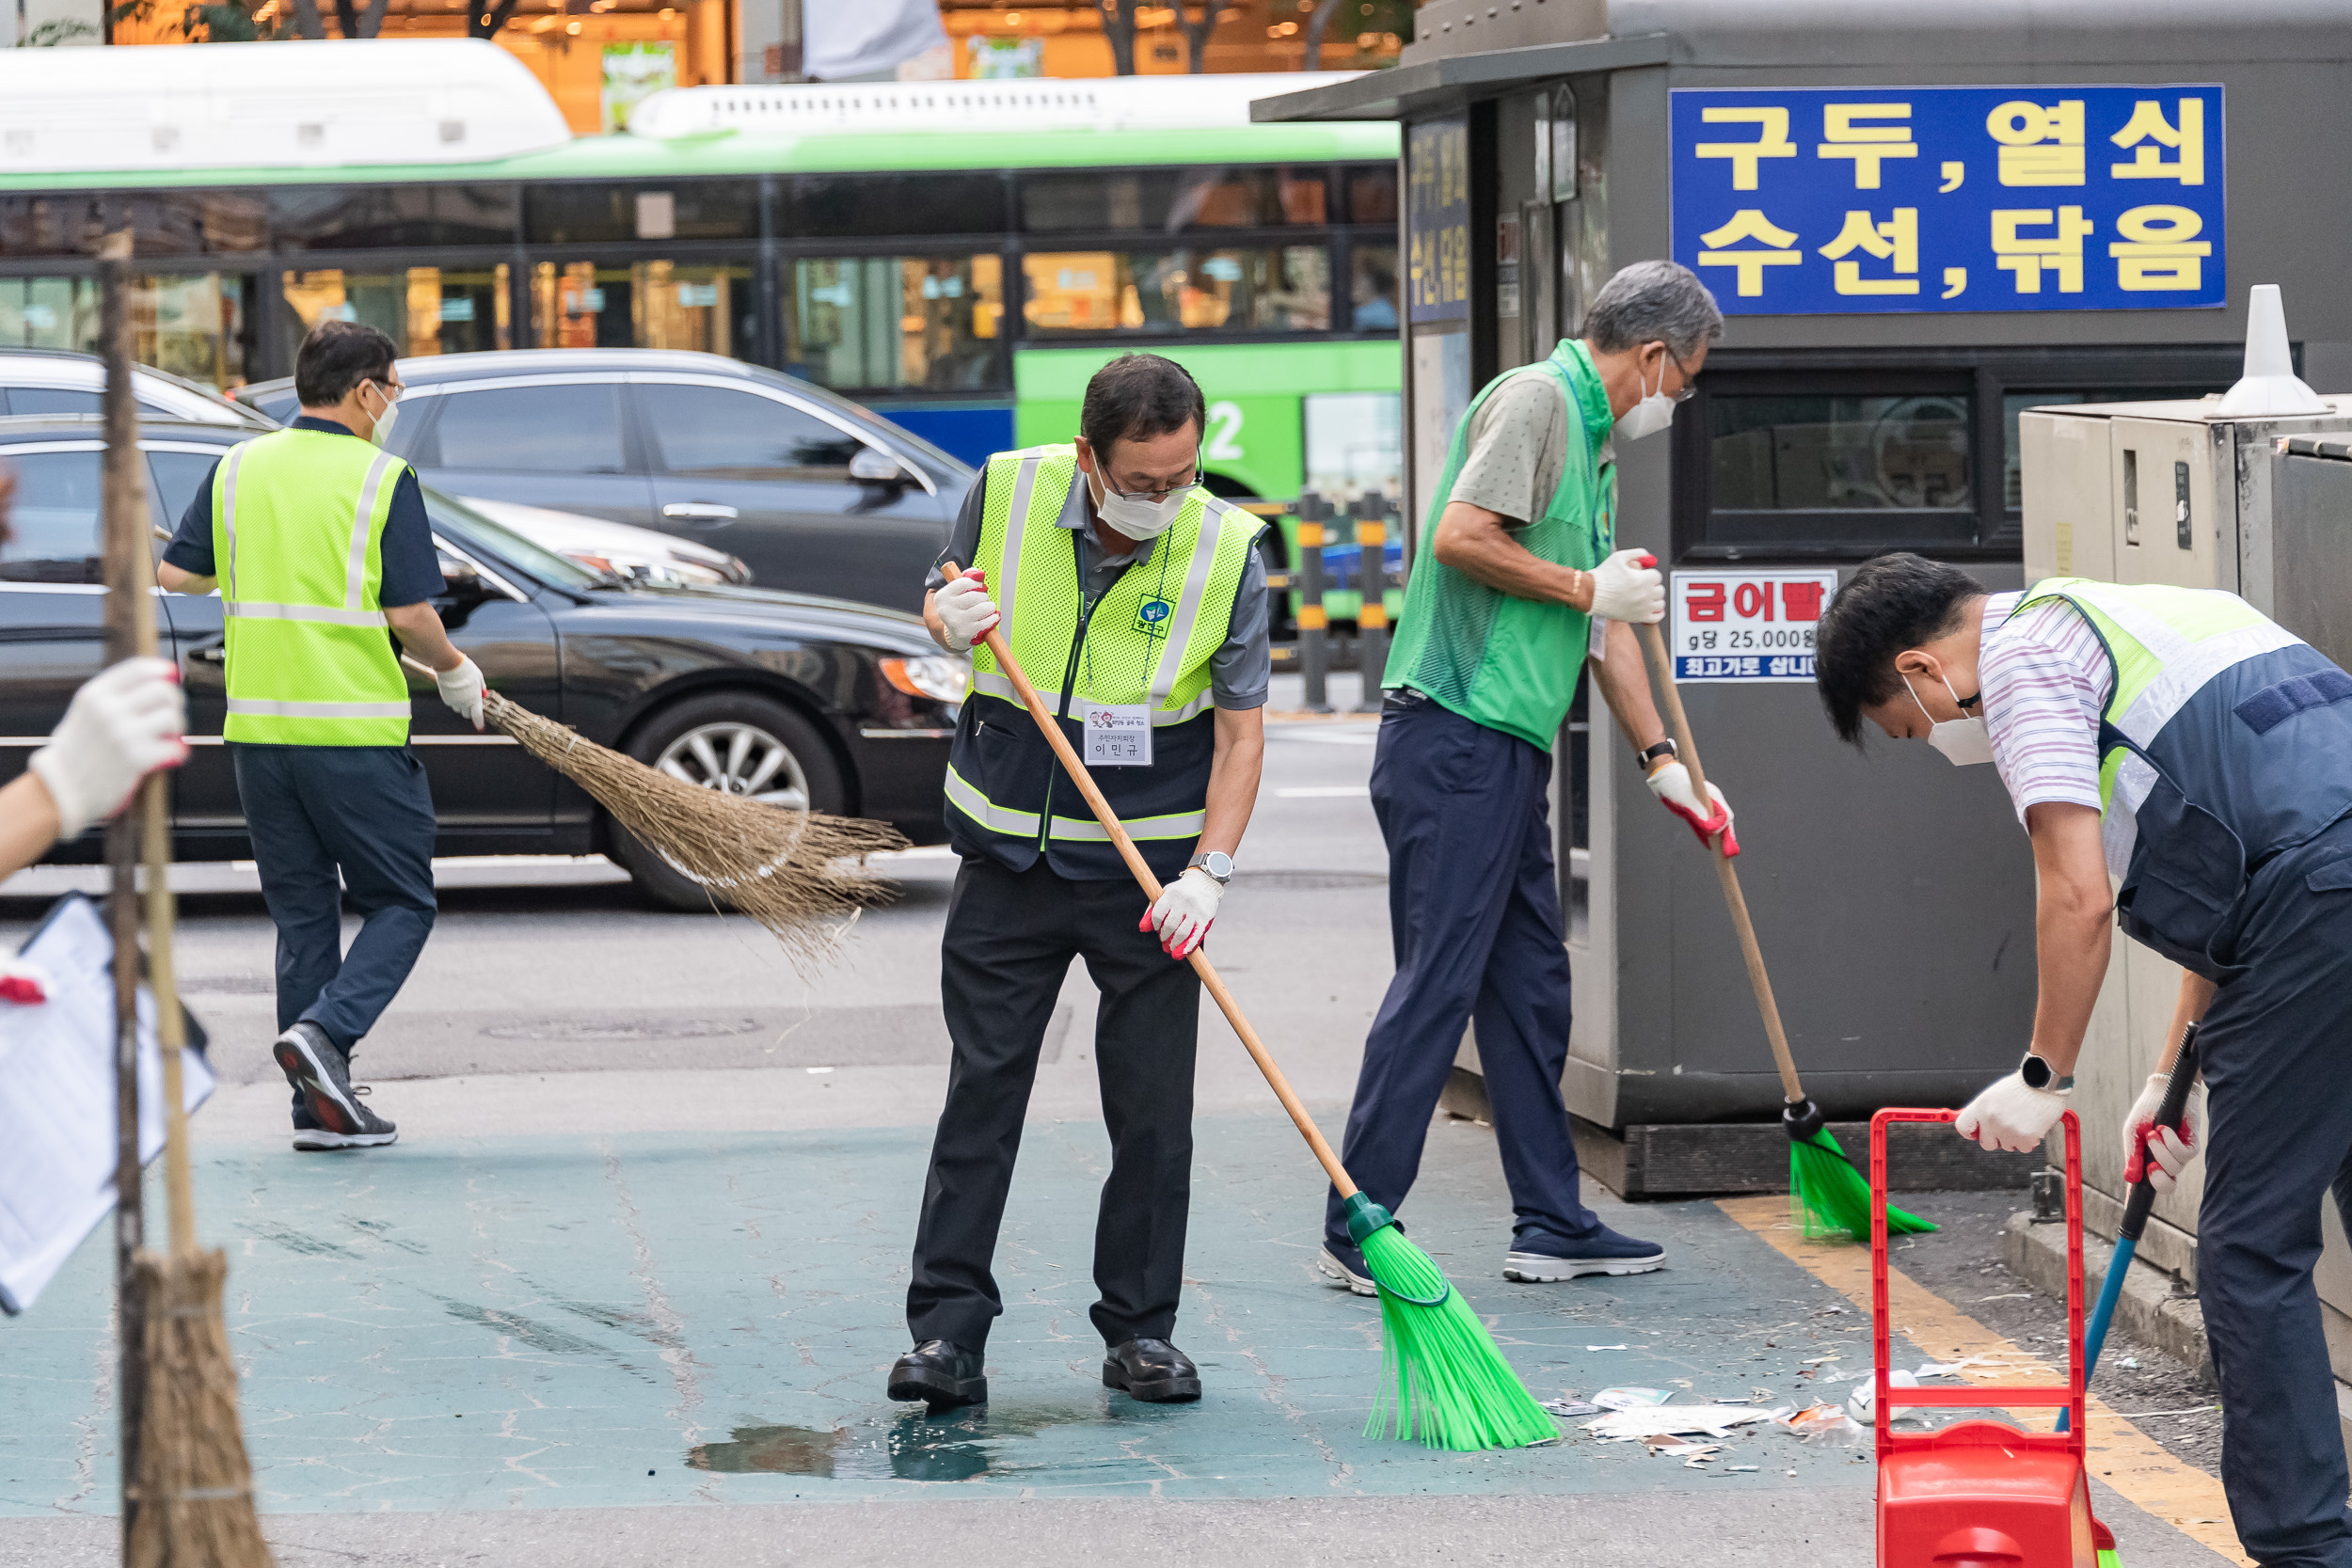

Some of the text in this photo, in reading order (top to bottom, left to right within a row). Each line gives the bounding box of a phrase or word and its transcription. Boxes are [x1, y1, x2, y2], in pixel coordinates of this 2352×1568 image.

[1686, 581, 1825, 622] 금이빨
[1689, 630, 1718, 650] g당
[1685, 657, 1761, 676] 최고가로
